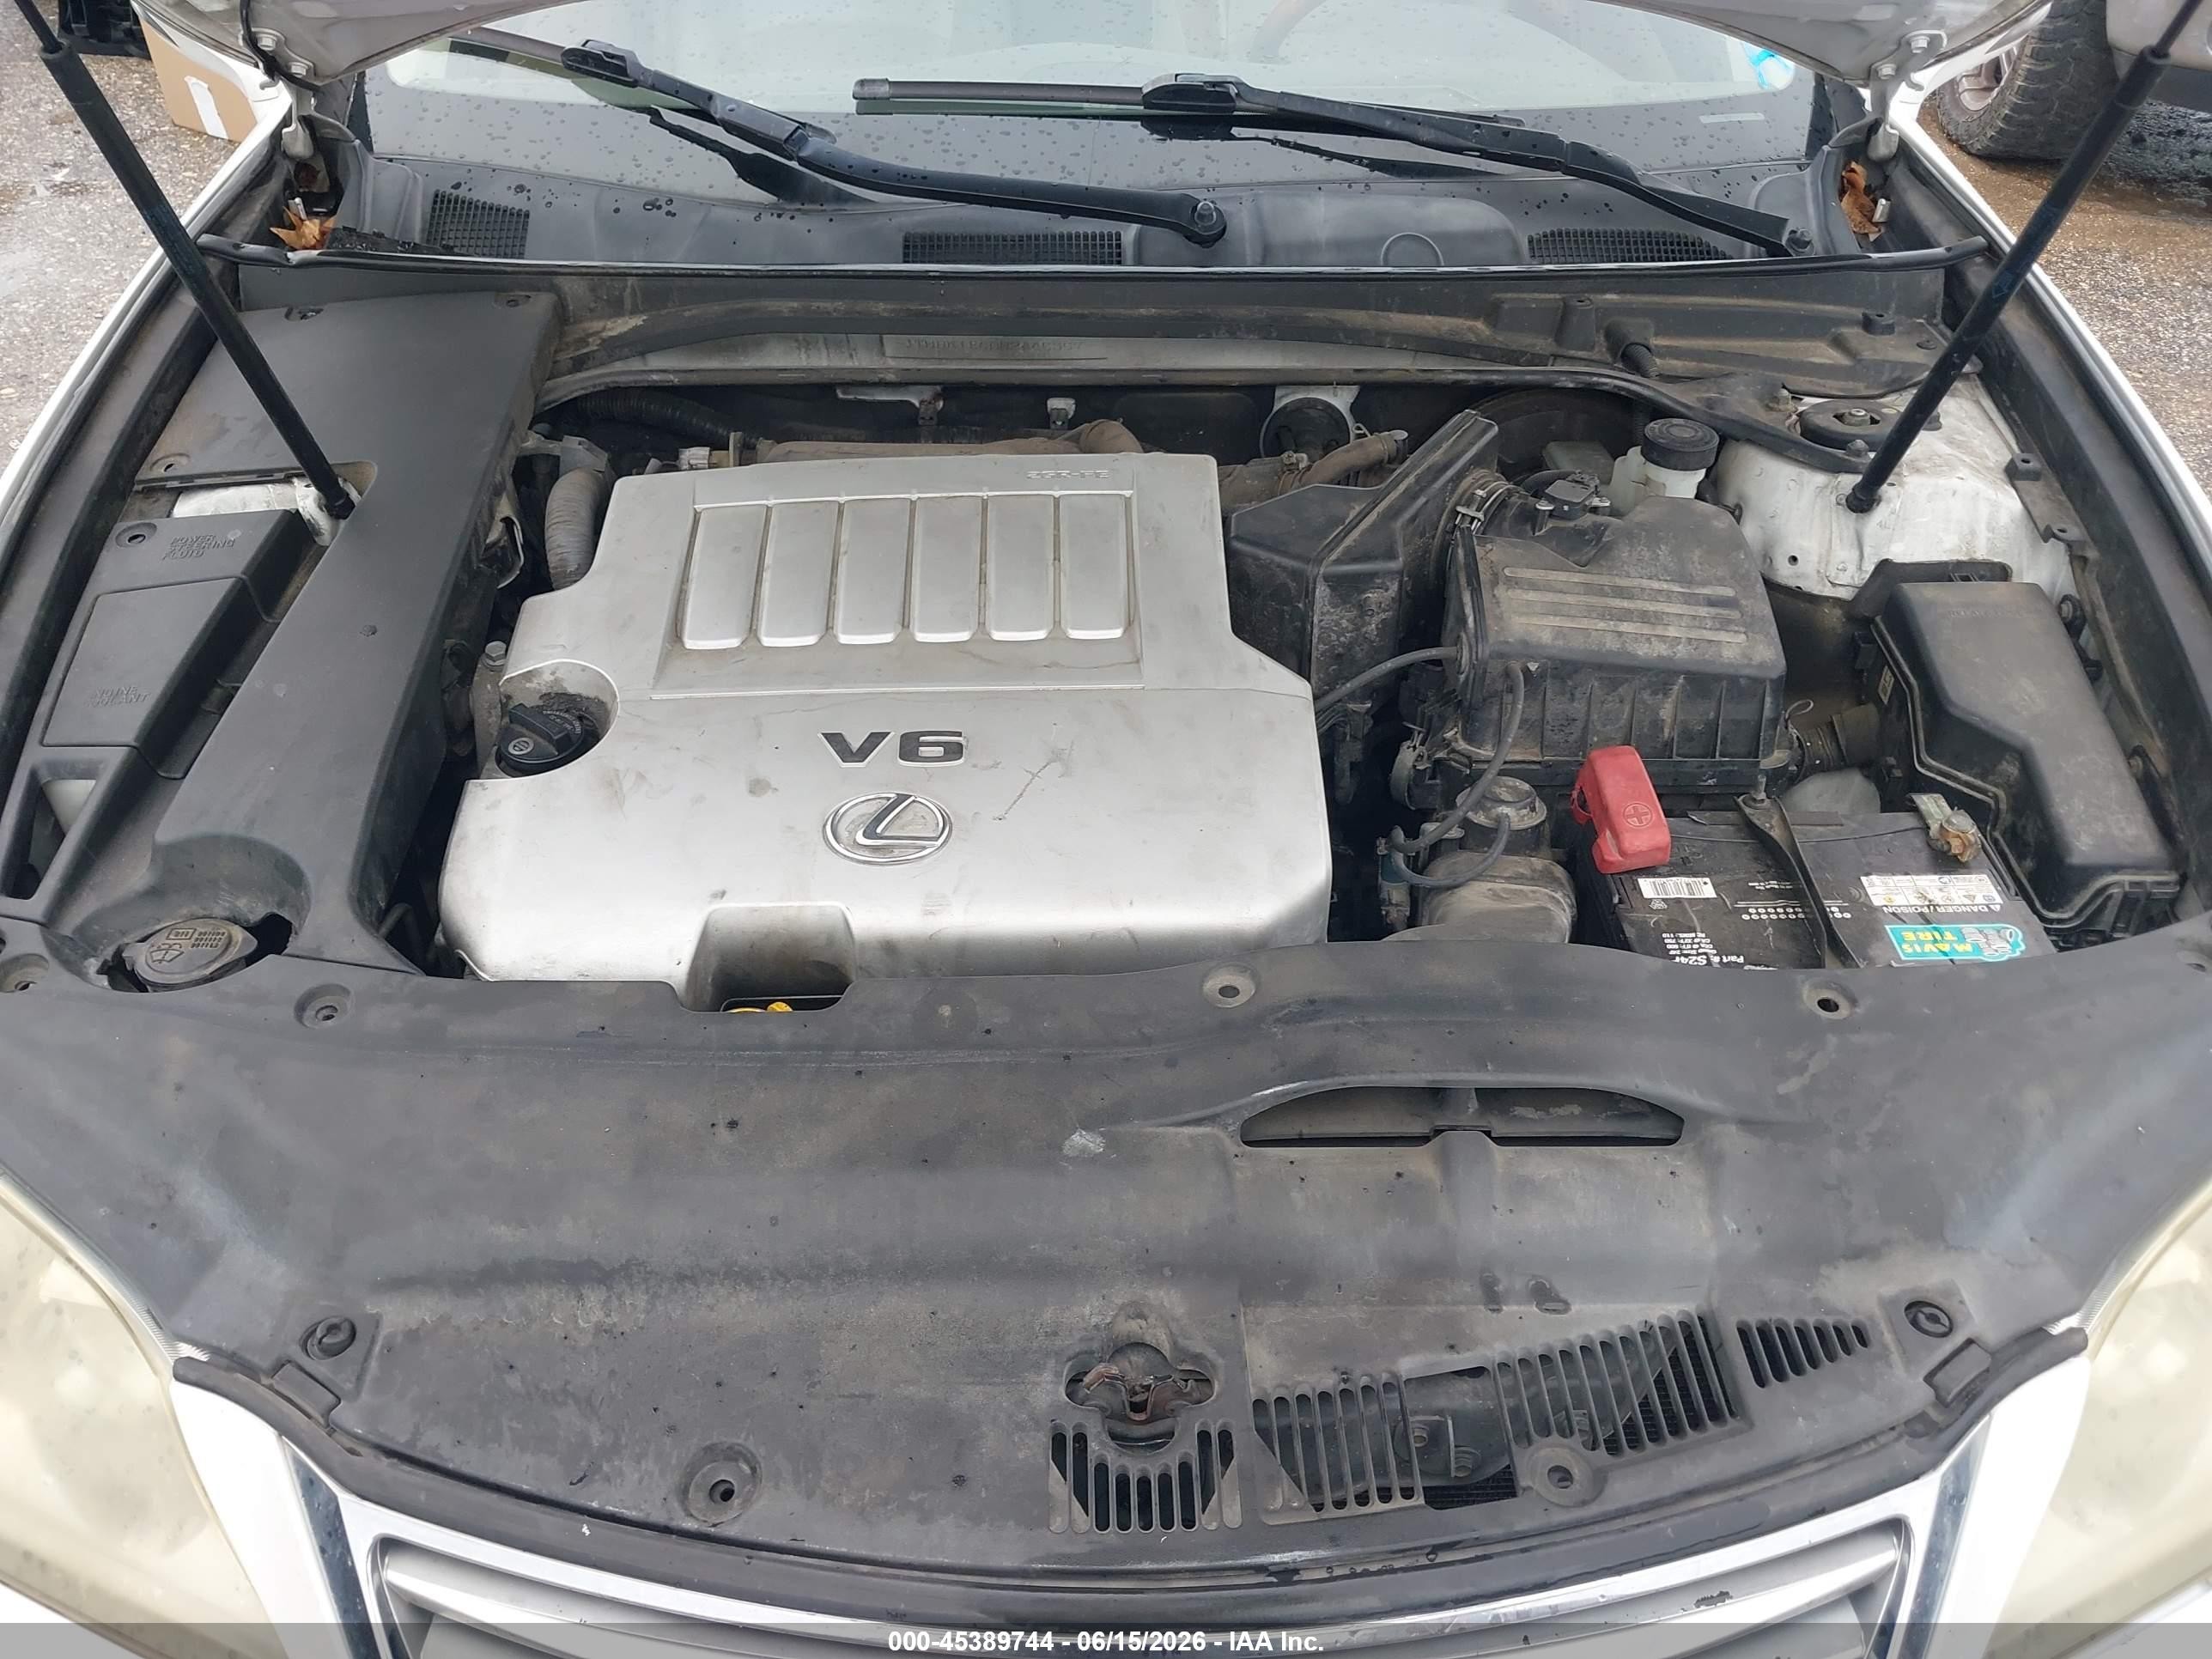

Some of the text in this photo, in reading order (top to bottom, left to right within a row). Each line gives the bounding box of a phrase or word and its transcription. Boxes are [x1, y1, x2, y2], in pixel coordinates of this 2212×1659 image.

[817, 729, 967, 769] V6
[1900, 931, 1958, 941] TIRE
[1900, 943, 1973, 953] MAVIS
[1721, 955, 1745, 963] Part
